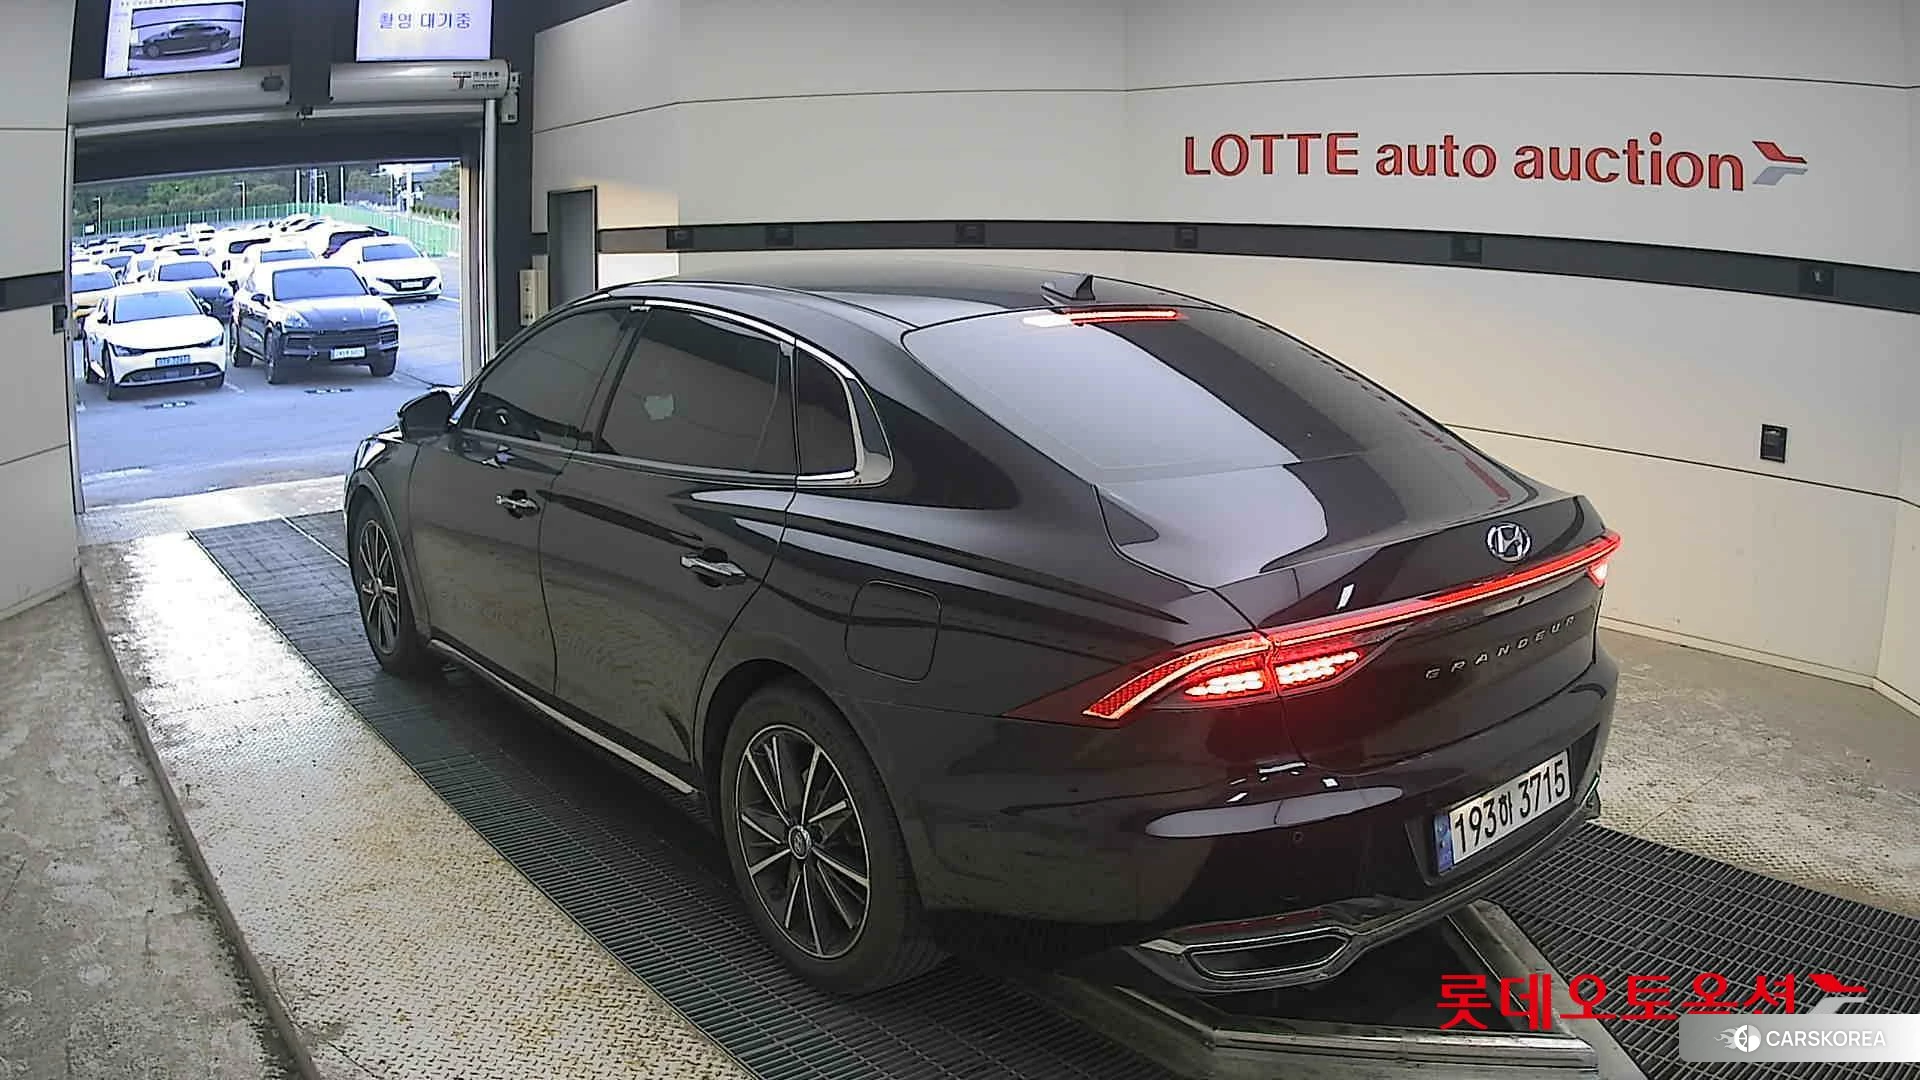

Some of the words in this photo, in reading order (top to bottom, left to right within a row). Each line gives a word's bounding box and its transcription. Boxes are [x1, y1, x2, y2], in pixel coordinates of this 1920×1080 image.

[420, 12, 471, 29] 대기중
[1184, 132, 1359, 177] LOTTE
[1375, 134, 1497, 178] auto
[1513, 131, 1744, 191] auction
[1425, 615, 1575, 679] GRANDEUR
[1454, 791, 1513, 854] 193하
[1518, 760, 1566, 818] 3715
